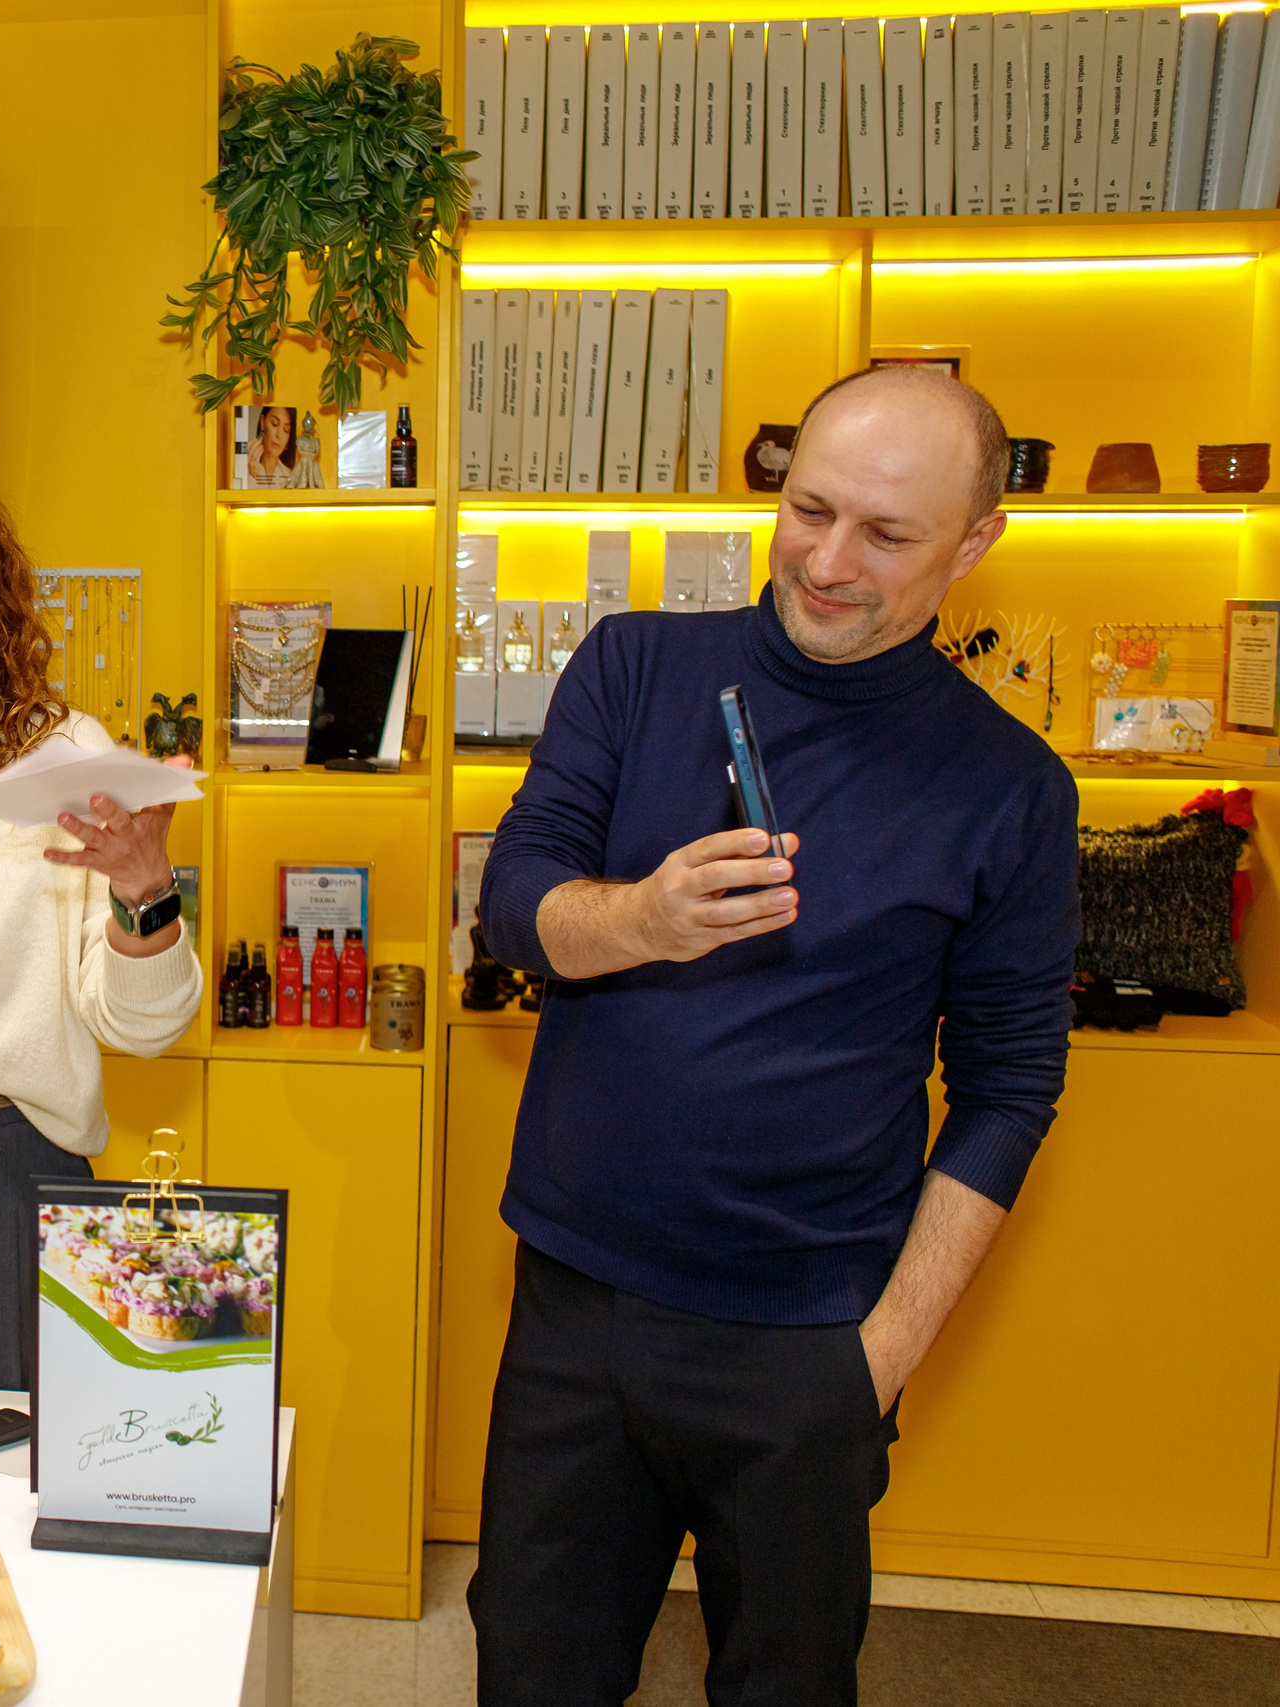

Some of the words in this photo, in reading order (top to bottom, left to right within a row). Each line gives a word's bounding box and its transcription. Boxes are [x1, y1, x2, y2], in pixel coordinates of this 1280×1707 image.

[781, 87, 789, 138] Стихотворения
[818, 82, 826, 133] Стихотворения
[972, 126, 980, 150] Против
[1005, 124, 1013, 149] Против
[1042, 125, 1050, 150] Против
[1074, 118, 1083, 143] Против
[1111, 119, 1120, 144] Против
[1149, 121, 1157, 146] Против
[1074, 178, 1078, 186] 5
[309, 896, 336, 904] TRAWA
[98, 1452, 134, 1466] авторские
[106, 1492, 197, 1505] www.brusketta.pro
